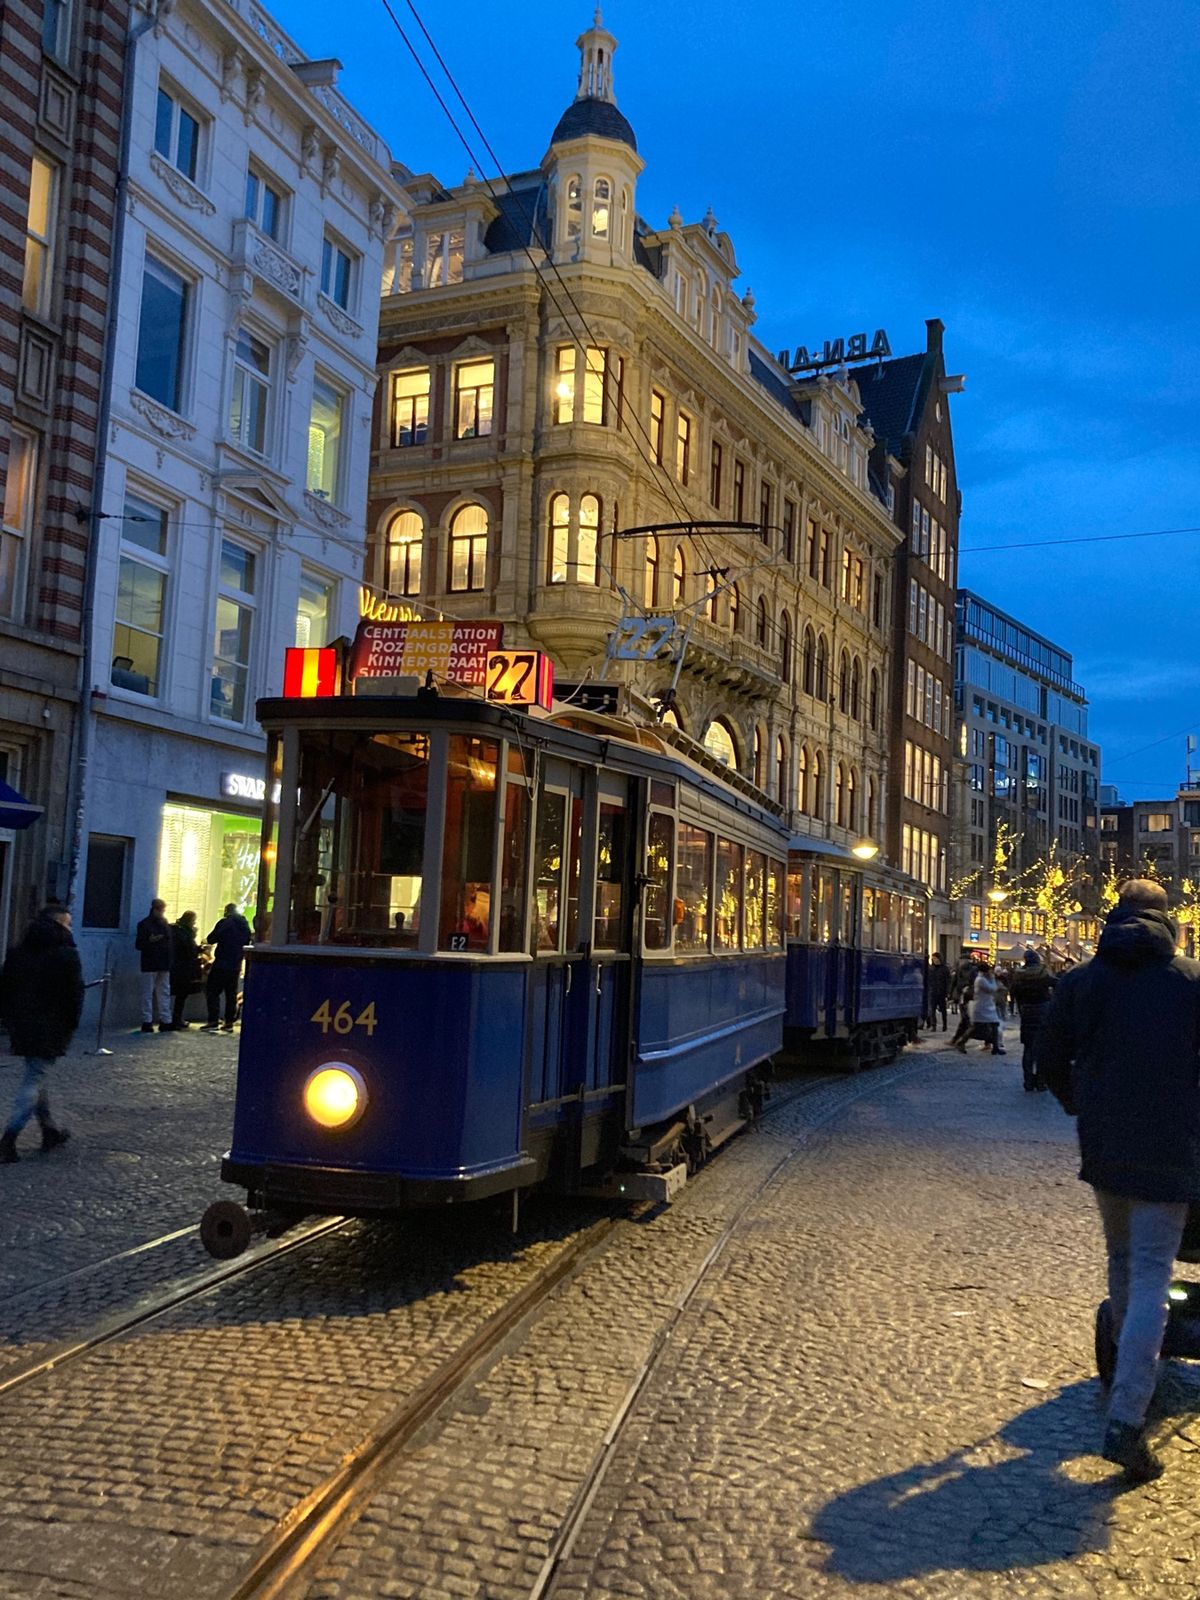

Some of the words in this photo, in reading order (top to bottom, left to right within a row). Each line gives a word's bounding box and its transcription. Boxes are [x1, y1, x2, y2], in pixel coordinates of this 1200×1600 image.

[364, 626, 497, 640] CENTRAALSTATION
[619, 617, 674, 659] 27
[372, 640, 487, 654] ROZENGRACHT
[367, 653, 486, 668] KINKERSTRAAT
[488, 655, 535, 700] 27
[450, 936, 466, 951] E2
[310, 999, 378, 1036] 464
